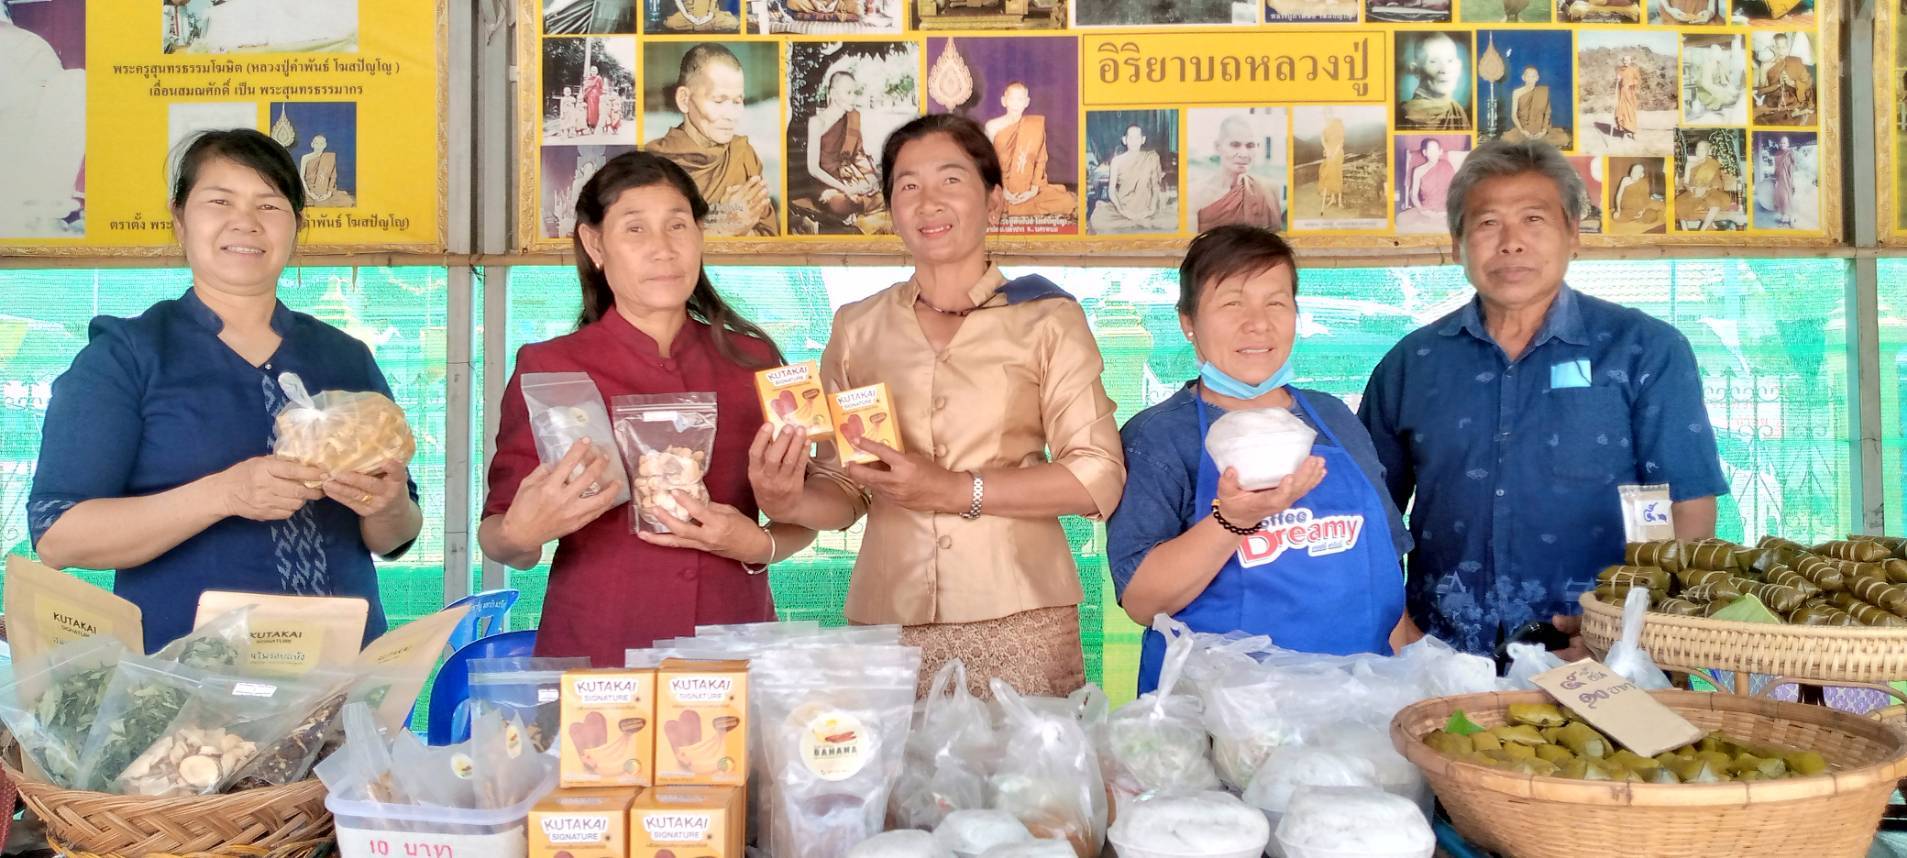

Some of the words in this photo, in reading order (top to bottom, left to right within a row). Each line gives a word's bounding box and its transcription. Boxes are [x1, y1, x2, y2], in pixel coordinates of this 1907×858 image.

[112, 59, 243, 79] พระครูสุนทรธรรมโฆษิต
[1097, 37, 1370, 97] อิริยาบถหลวงปู่
[234, 81, 256, 97] เป็น
[260, 84, 363, 100] พระสุนทรธรรมากร
[109, 211, 146, 231] ตราตั้ง
[150, 220, 175, 231] พระ
[767, 365, 808, 381] KUTAKAI
[837, 389, 876, 405] KUTAKAI
[1260, 511, 1308, 530] offee
[1239, 518, 1358, 562] Dreamy
[53, 611, 97, 635] KUTAKAI
[576, 681, 637, 693] KUTAKAI
[671, 679, 731, 691] KUTAKAI
[544, 818, 607, 831] KUTAKAI
[646, 816, 709, 830] KUTAKAI
[551, 832, 599, 841] SIGNATURE
[654, 831, 700, 840] SIGNATURE
[369, 839, 389, 856] 10
[403, 842, 453, 858] บาท
